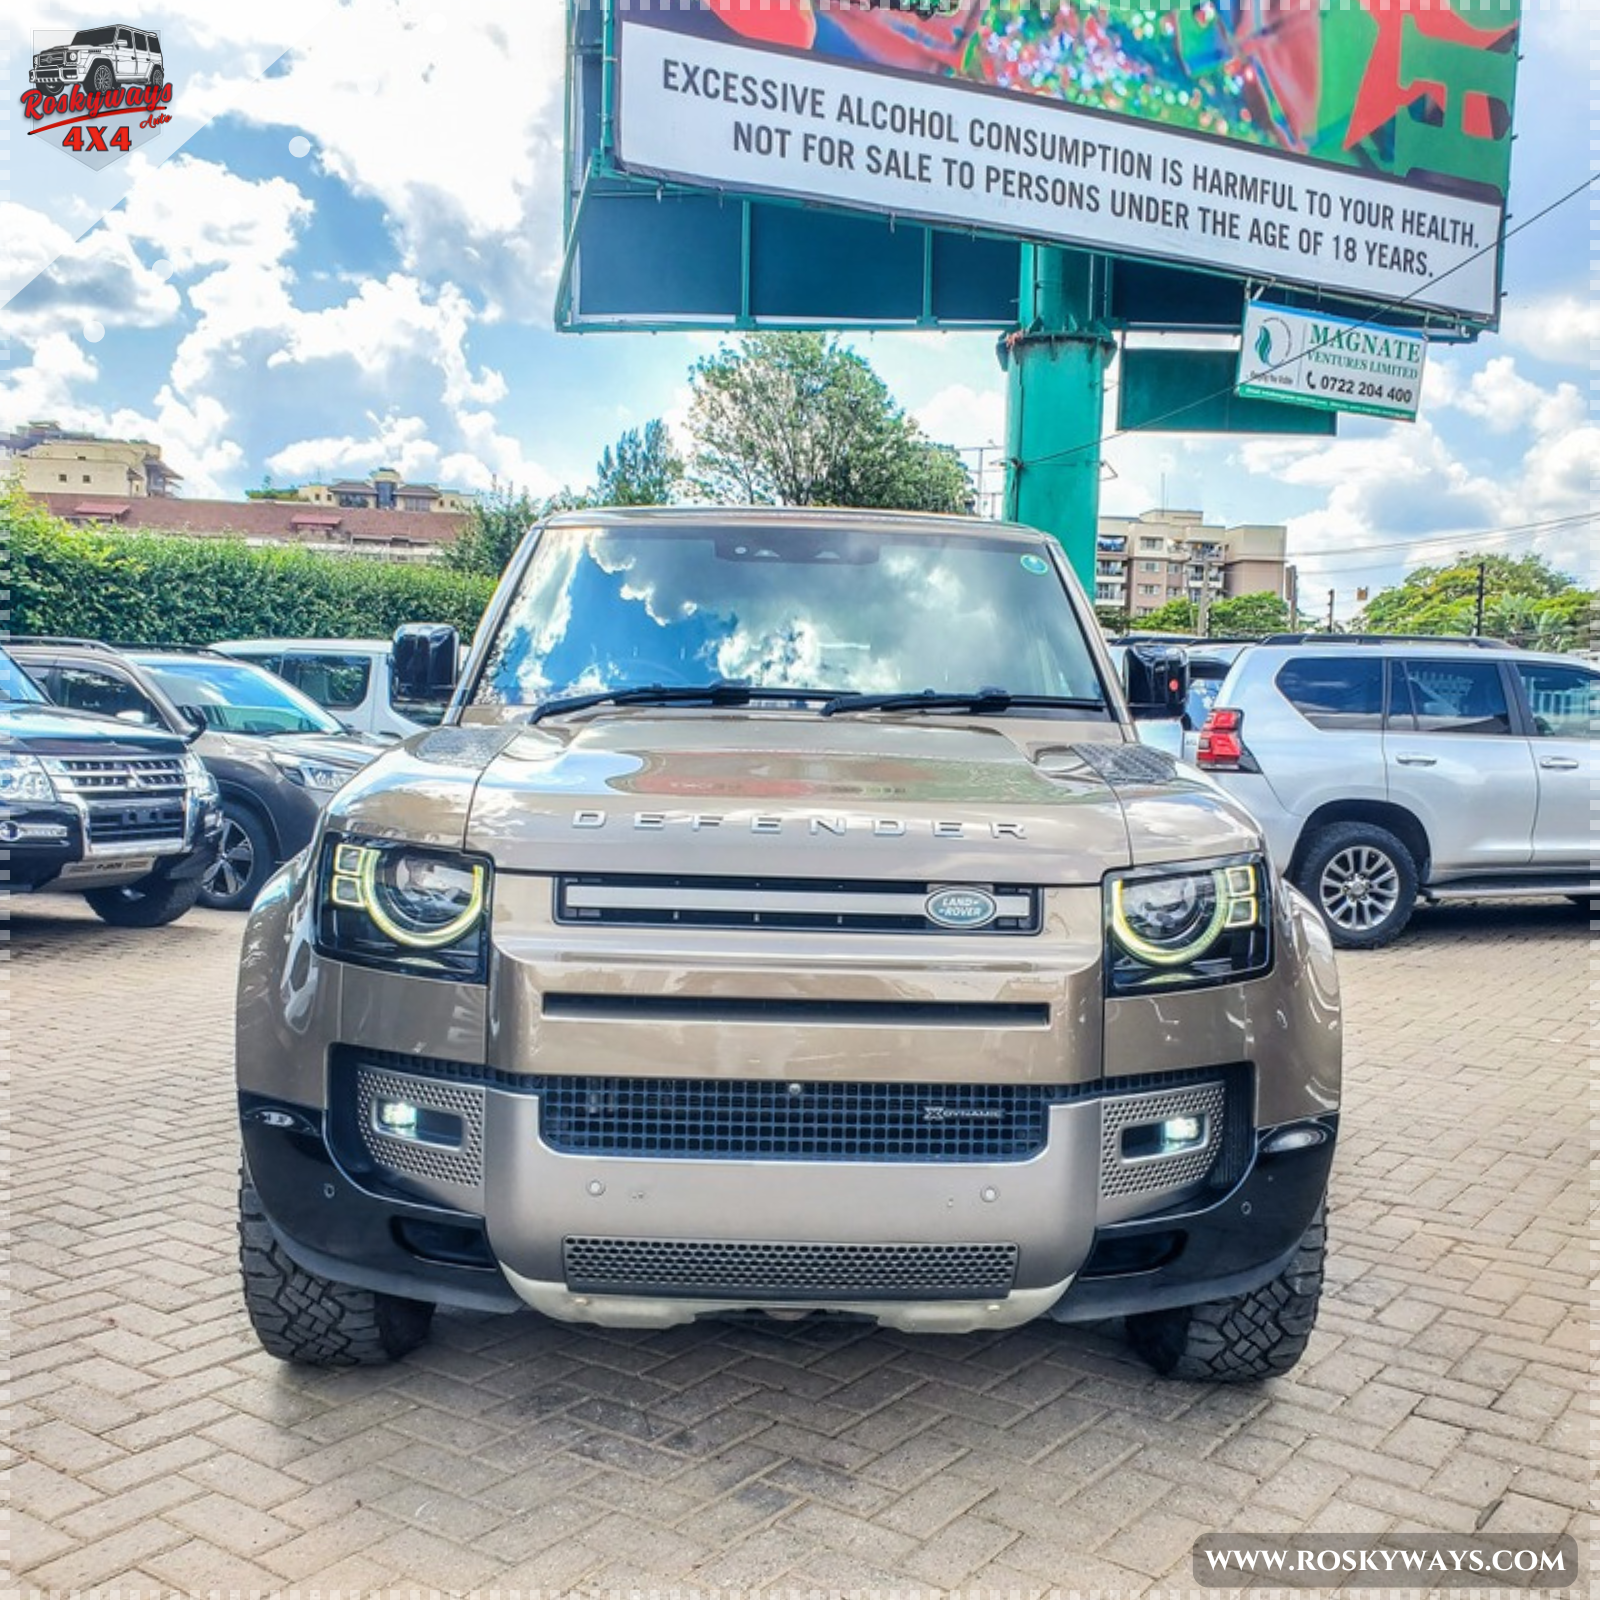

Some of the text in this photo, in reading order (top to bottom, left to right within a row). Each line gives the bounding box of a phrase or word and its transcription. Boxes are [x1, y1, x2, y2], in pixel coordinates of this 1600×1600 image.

[662, 58, 1480, 249] EXCESSIVE ALCOHOL CONSUMPTION IS HARMFUL TO YOUR HEALTH.
[733, 120, 1434, 279] NOT FOR SALE TO PERSONS UNDER THE AGE OF 18 YEARS.
[1310, 324, 1420, 363] MAGNATE
[1308, 351, 1418, 380] VENTURES LIMITED
[1320, 375, 1354, 393] 0722
[1358, 382, 1383, 399] 204
[1387, 388, 1413, 404] 400
[571, 809, 1027, 840] DEFENDER
